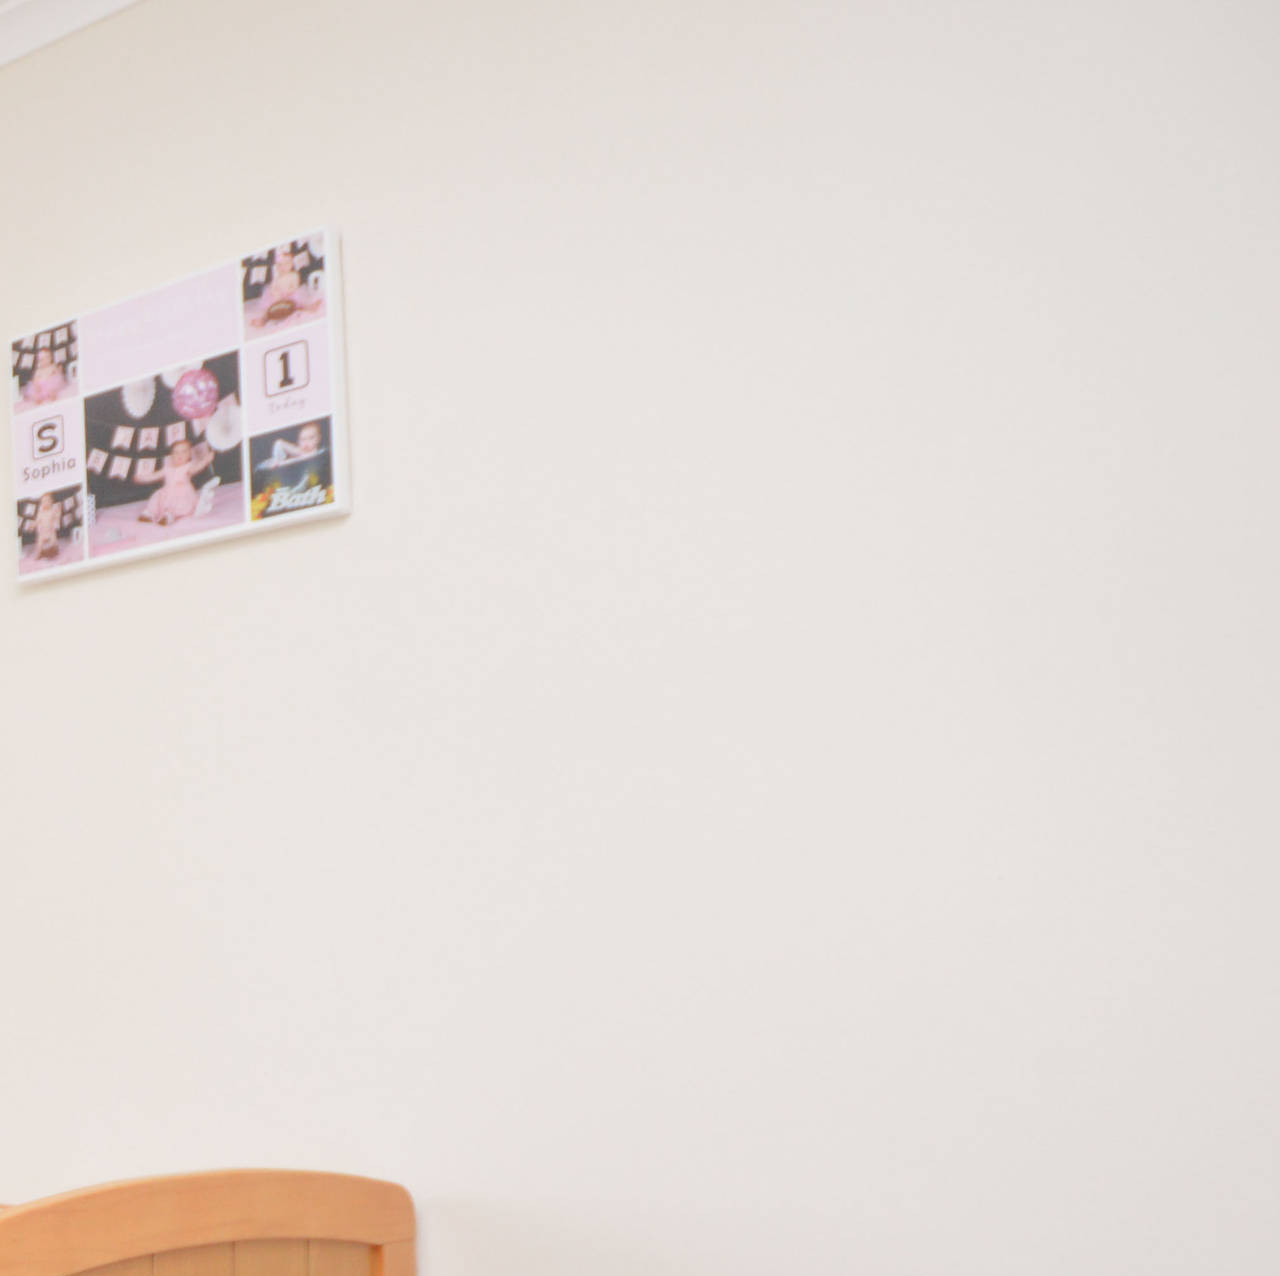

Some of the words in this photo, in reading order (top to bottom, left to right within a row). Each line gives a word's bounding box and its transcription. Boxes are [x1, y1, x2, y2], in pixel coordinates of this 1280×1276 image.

[279, 350, 295, 388] 1
[37, 422, 59, 453] S
[23, 456, 76, 482] Sophia
